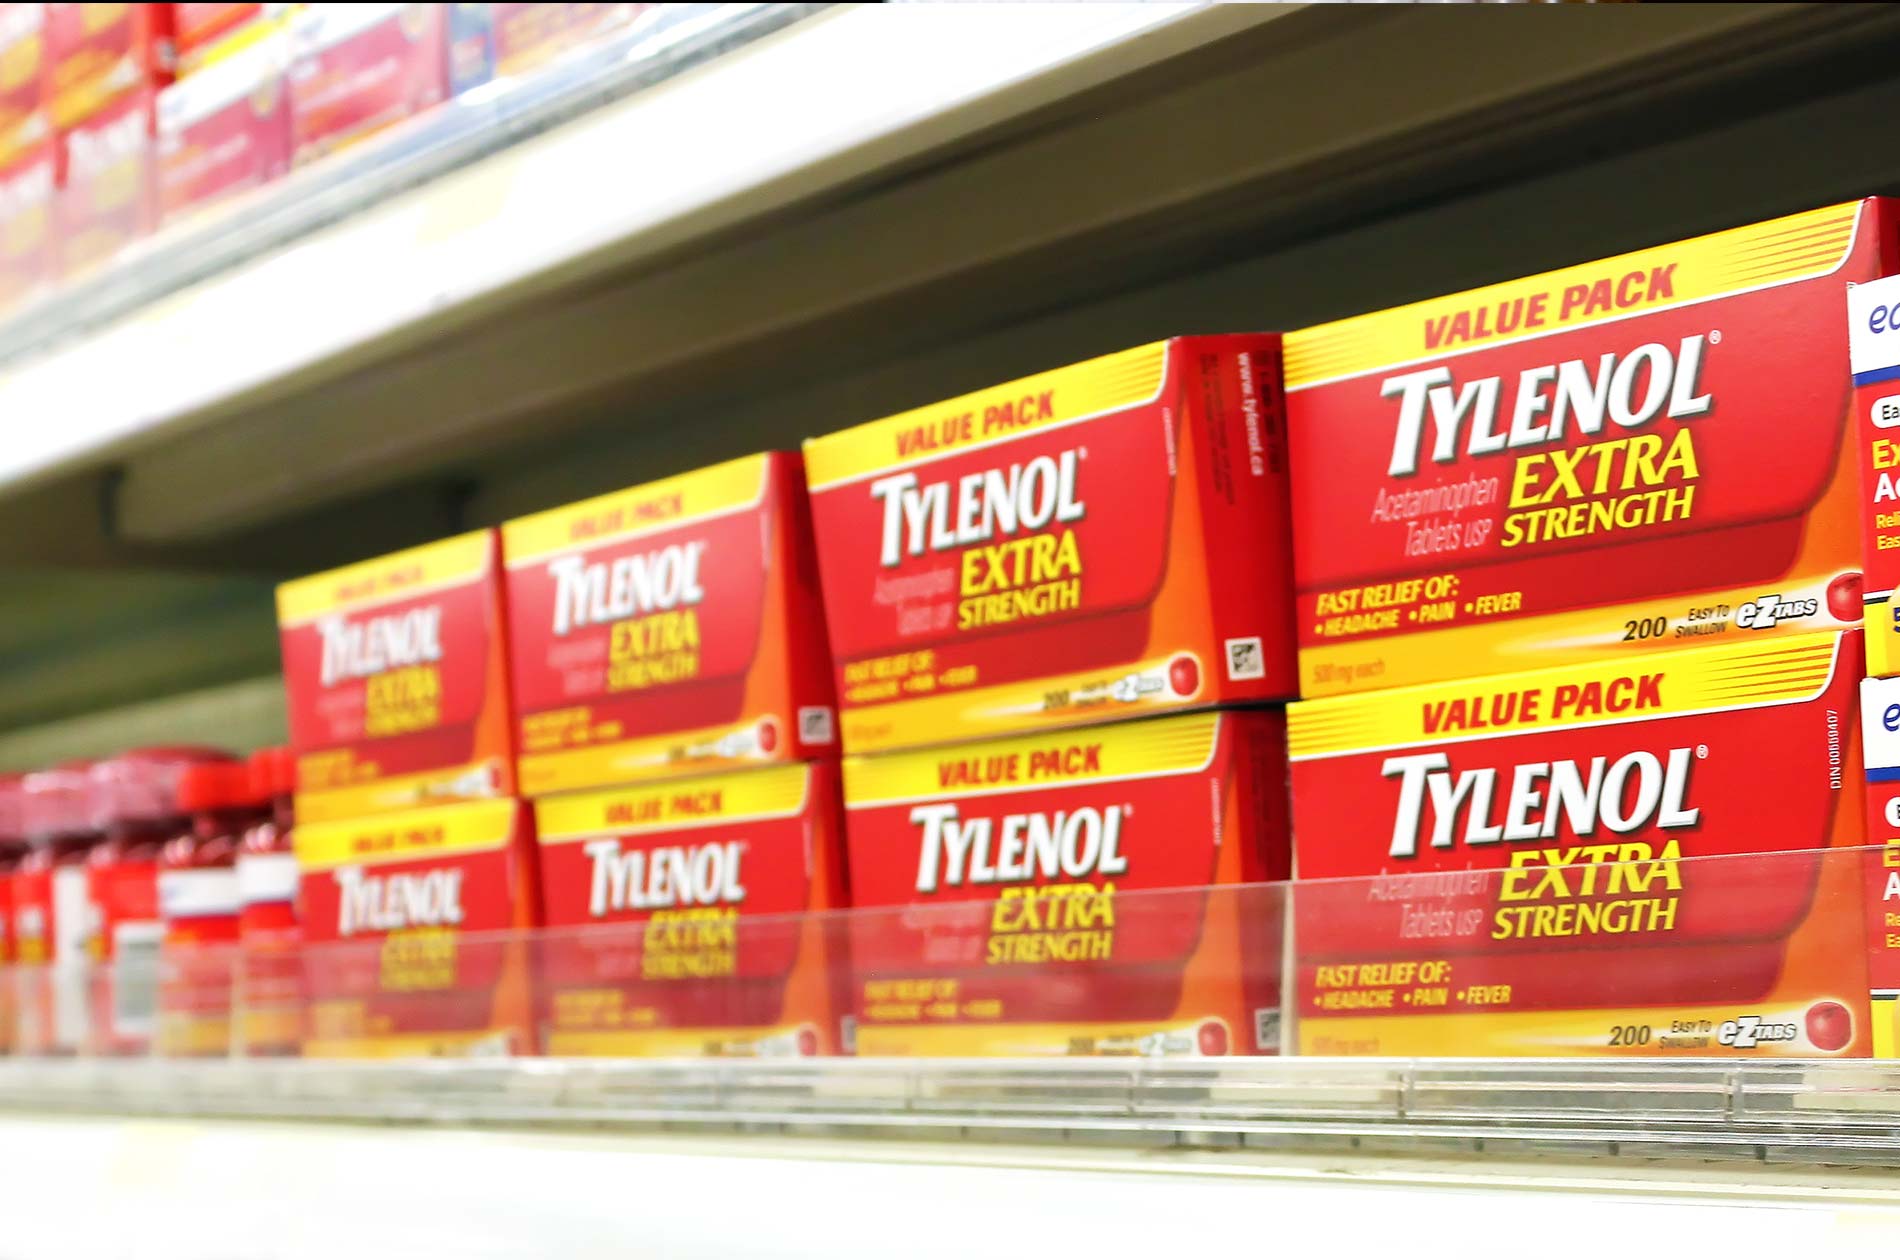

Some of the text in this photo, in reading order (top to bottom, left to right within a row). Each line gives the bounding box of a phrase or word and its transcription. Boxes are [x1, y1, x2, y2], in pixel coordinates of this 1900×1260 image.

[1424, 263, 1678, 350] VALUE PACK
[896, 389, 1054, 457] VALUE PACK
[1237, 352, 1264, 476] www.tylenol.ca
[1380, 334, 1712, 477] TYLENOL
[1508, 428, 1700, 509] EXTRA
[871, 449, 1085, 567] TYLENOL
[1370, 472, 1499, 524] Acetaminophen
[1501, 485, 1696, 547] STRENGTH
[959, 529, 1082, 598] EXTRA
[1404, 521, 1462, 557] Tablets
[548, 540, 705, 636] TYLENOL
[957, 577, 1081, 630] STRENGTH
[1315, 575, 1460, 617] FAST RELIEF OF:
[1418, 601, 1456, 624] PAIN
[1475, 591, 1523, 615] FEVER
[1622, 616, 1668, 641] 200
[1422, 672, 1665, 734] VALUE PACK
[938, 743, 1103, 787] VALUE PACK
[1829, 766, 1842, 790] DIN
[1381, 748, 1700, 857] TYLENOL
[910, 802, 1128, 892] TYLENOL
[1498, 839, 1683, 901] EXTRA
[582, 839, 747, 918] TYLENOL
[992, 882, 1115, 932] EXTRA
[1491, 897, 1680, 939] STRENGTH
[986, 930, 1113, 965] STRENGTH
[1315, 960, 1453, 988] FAST RELIEF OF:
[1412, 987, 1449, 1006] PAIN
[1467, 985, 1513, 1005] FEVER
[1608, 1025, 1651, 1046] 200
